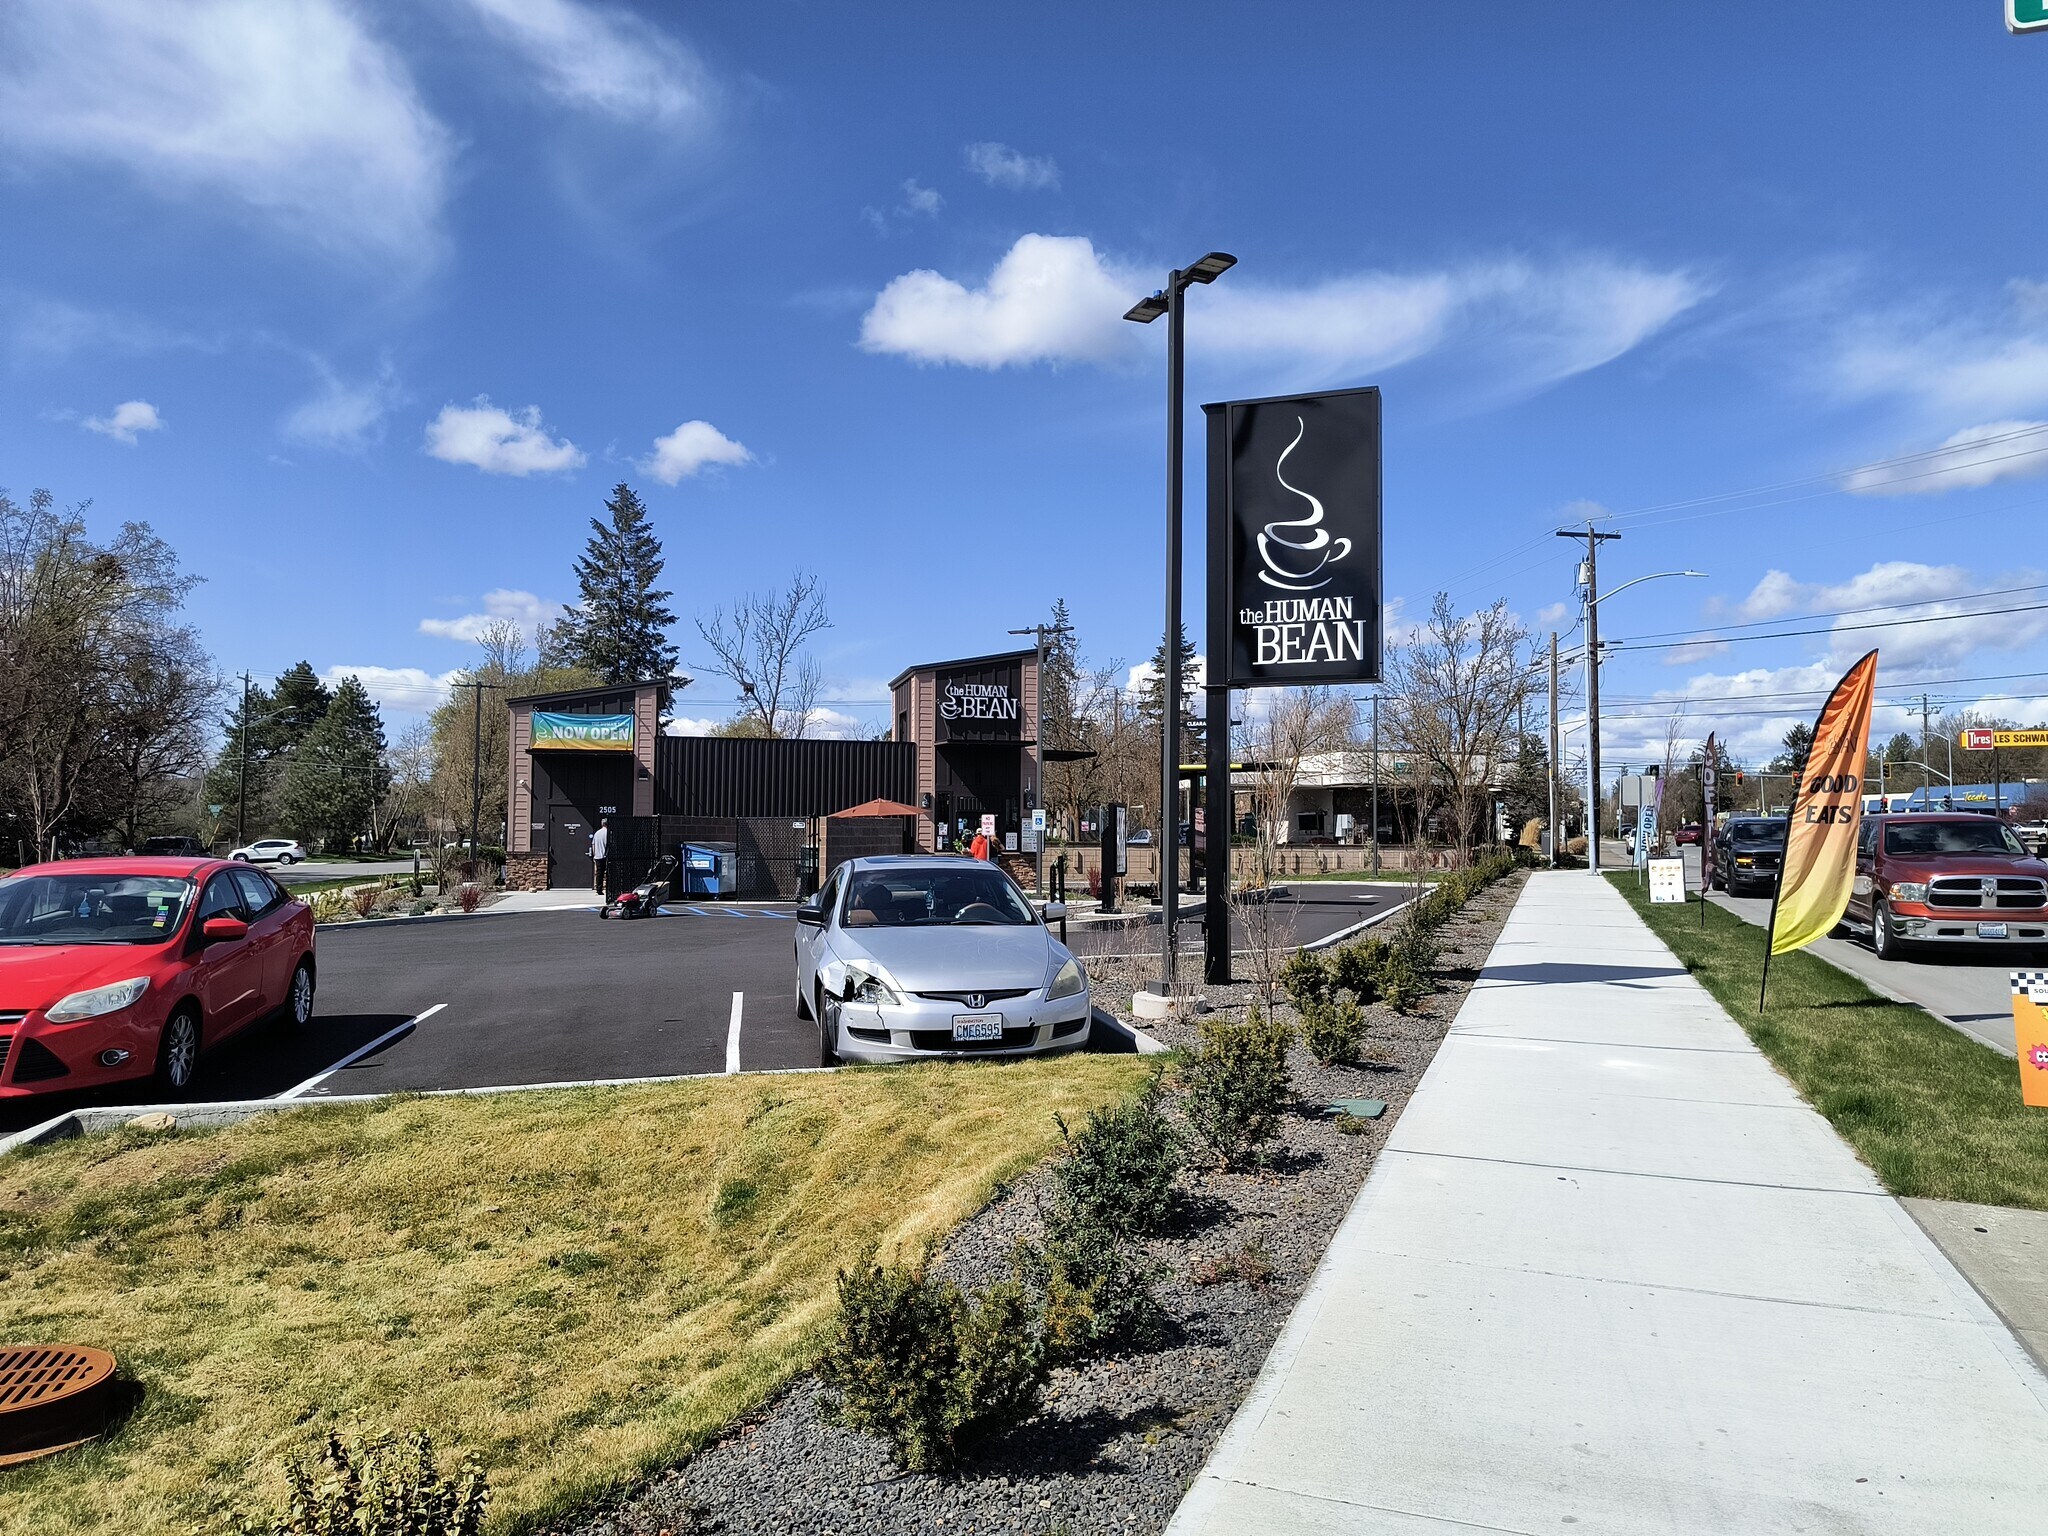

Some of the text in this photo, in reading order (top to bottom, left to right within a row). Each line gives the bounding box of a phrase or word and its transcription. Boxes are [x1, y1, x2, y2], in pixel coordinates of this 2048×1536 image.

[1239, 596, 1354, 625] the HUMAN
[1252, 620, 1367, 665] BEAN
[949, 684, 1008, 697] the HUMAN
[960, 696, 1018, 719] BEAN
[552, 726, 629, 740] NOW OPEN
[1969, 732, 1990, 747] Tires
[1994, 734, 2010, 744] LES
[1809, 774, 1858, 794] GOOD
[599, 806, 617, 814] 2505
[1805, 804, 1853, 824] EATS
[957, 1023, 1000, 1037] CME6595
